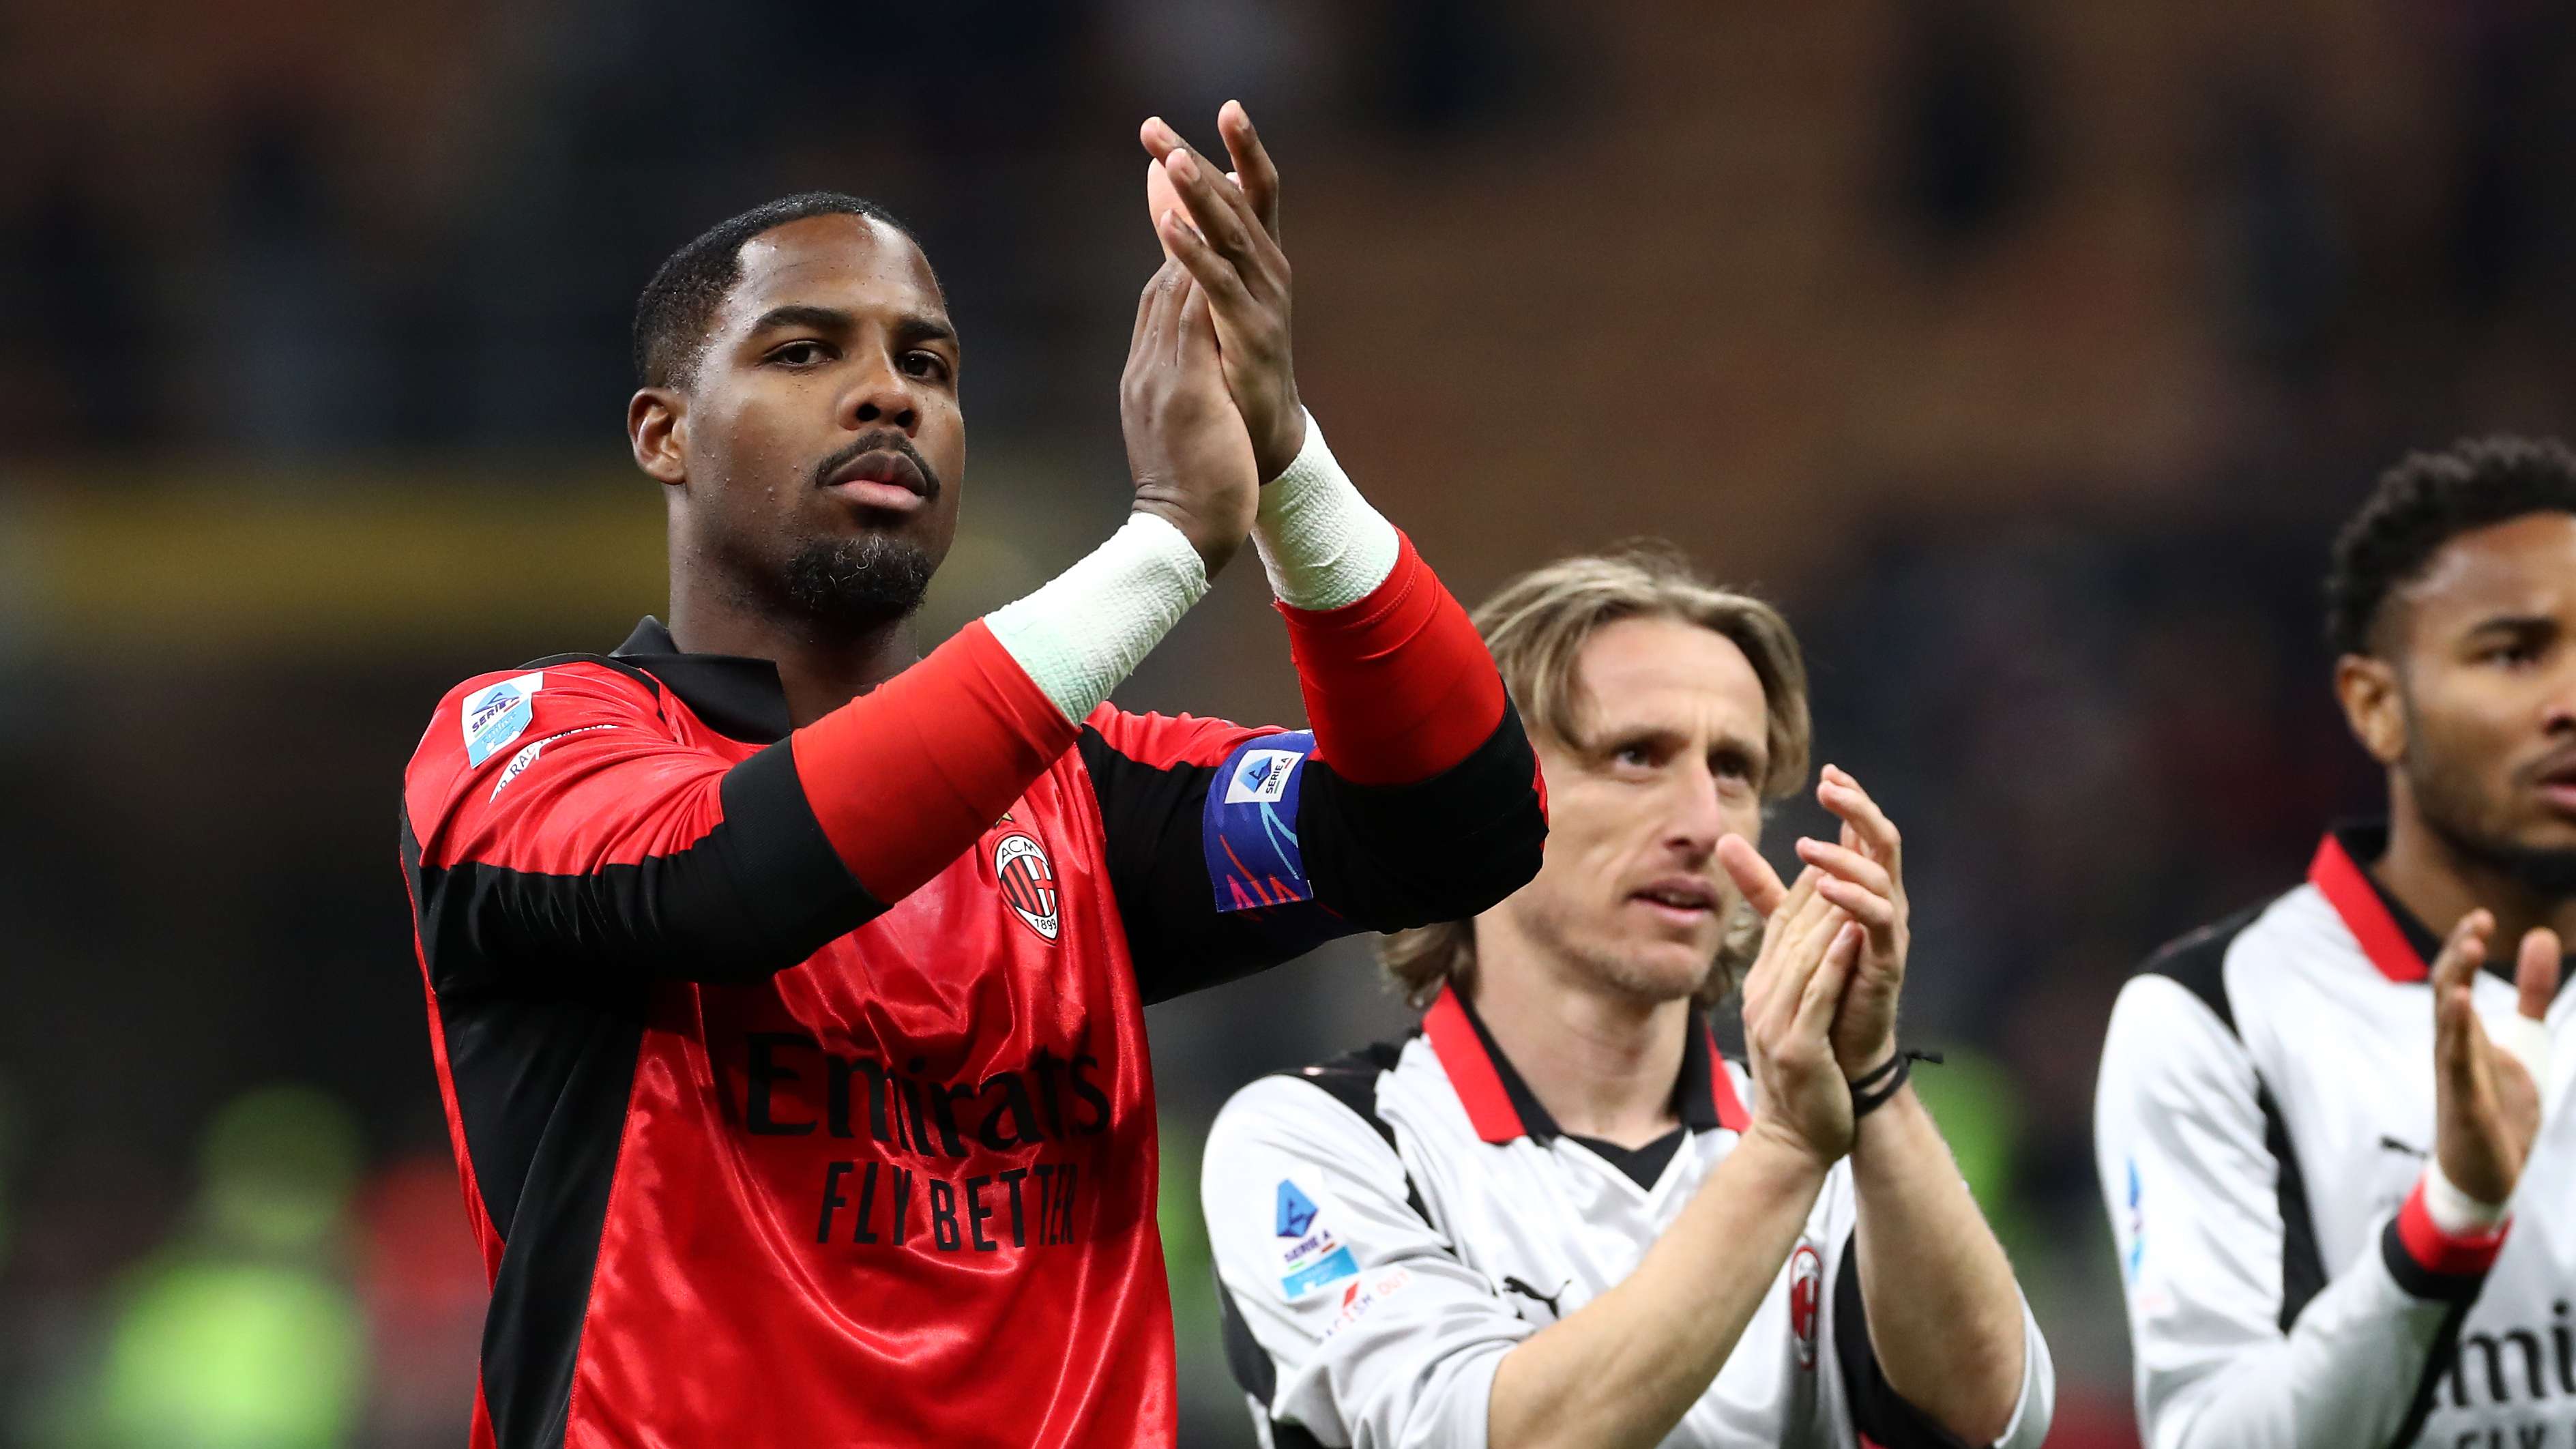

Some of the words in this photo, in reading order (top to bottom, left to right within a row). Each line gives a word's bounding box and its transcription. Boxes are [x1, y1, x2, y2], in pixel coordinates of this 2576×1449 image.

[1265, 764, 1283, 794] SERIE
[1001, 840, 1039, 864] ACM
[1034, 918, 1057, 931] 1899
[817, 1161, 912, 1246] FLY
[929, 1162, 1078, 1252] BETTER
